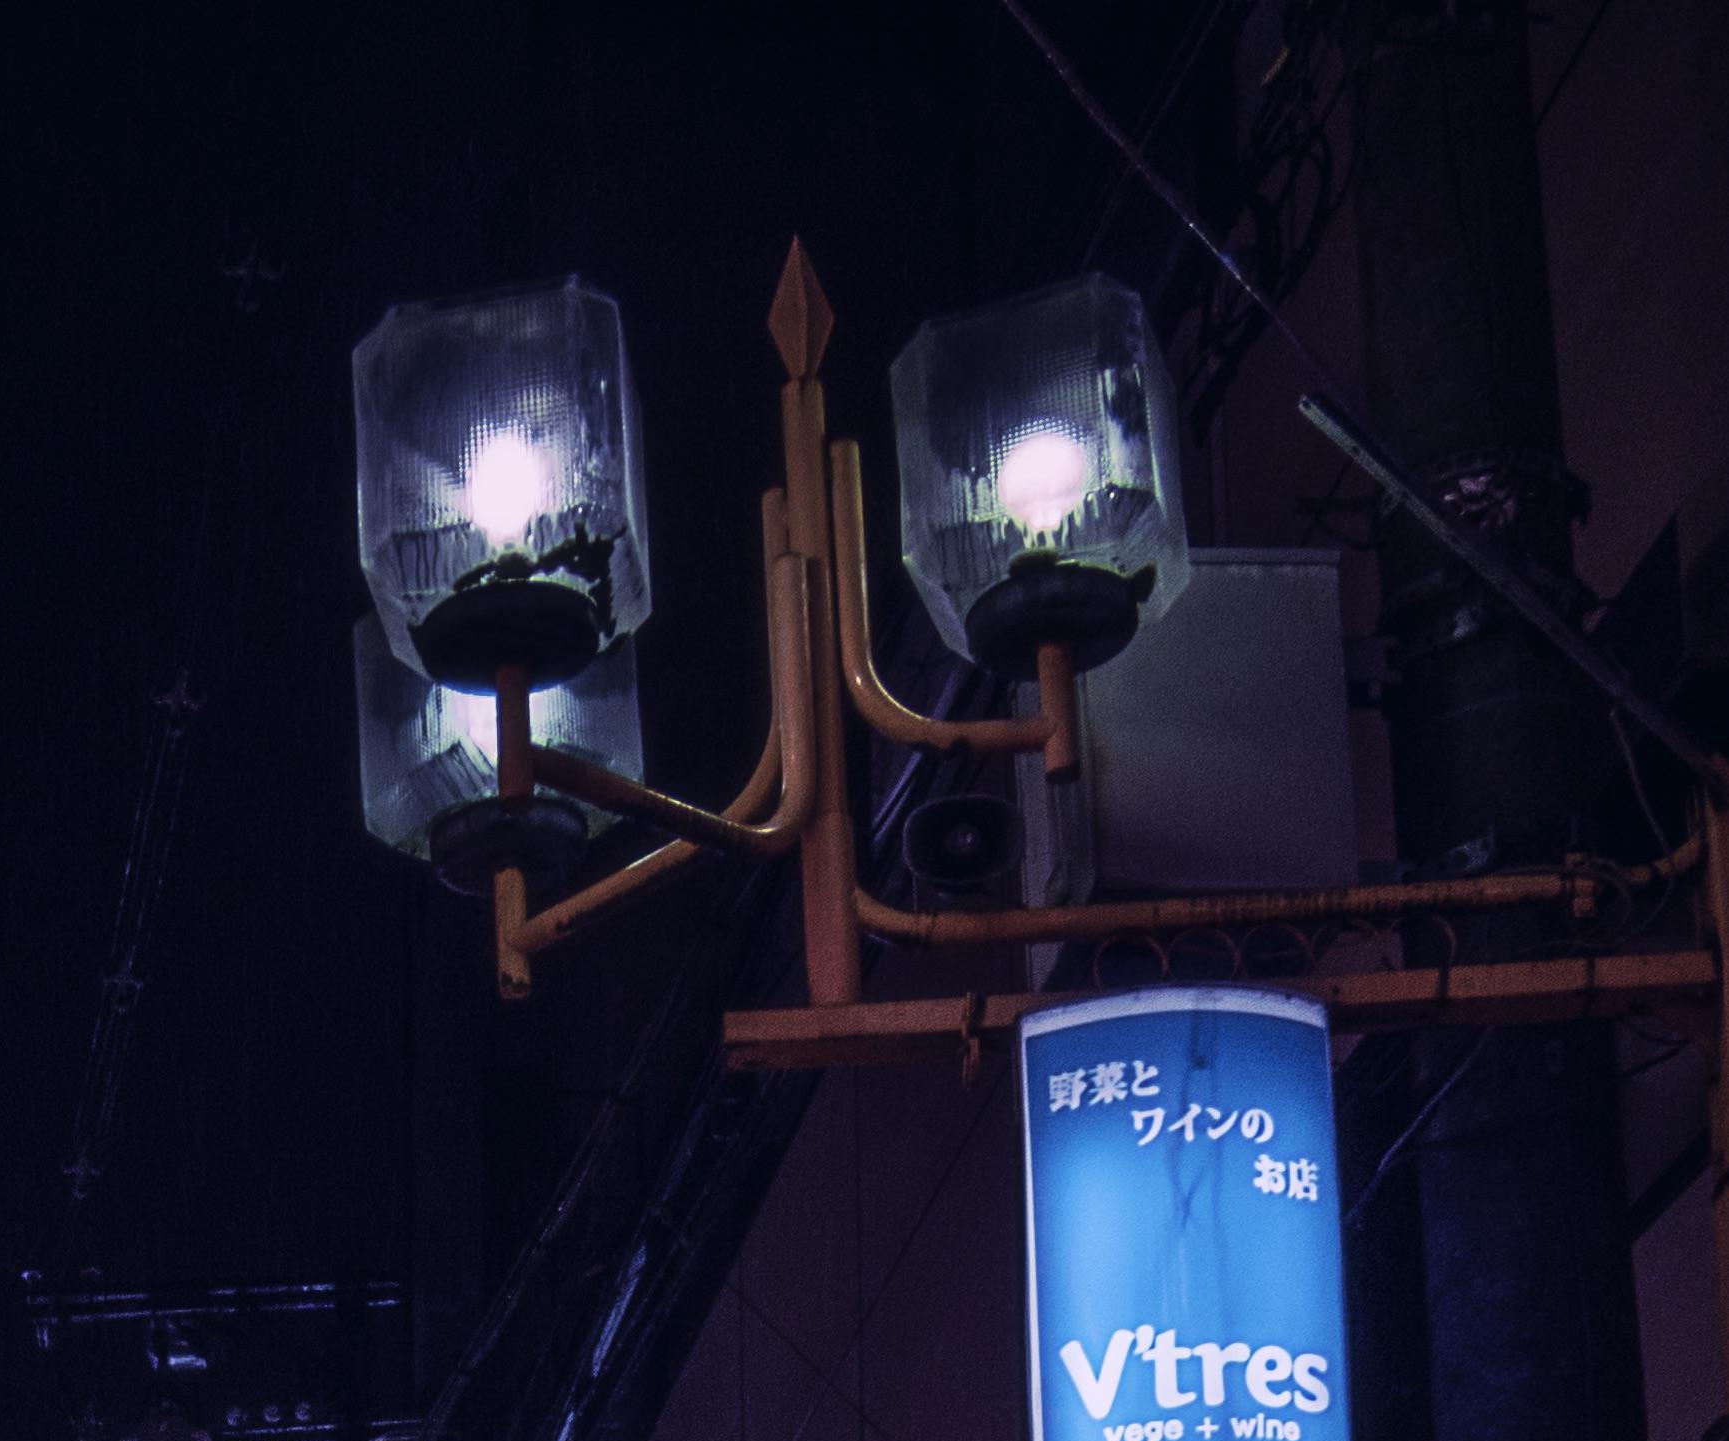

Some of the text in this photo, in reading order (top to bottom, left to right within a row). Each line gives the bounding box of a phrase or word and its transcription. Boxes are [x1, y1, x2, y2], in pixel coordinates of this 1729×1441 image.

[1048, 1059, 1161, 1112] 野菜と
[1131, 1103, 1274, 1146] ワインの
[1252, 1153, 1320, 1200] お店
[1059, 1322, 1331, 1421] V'tres
